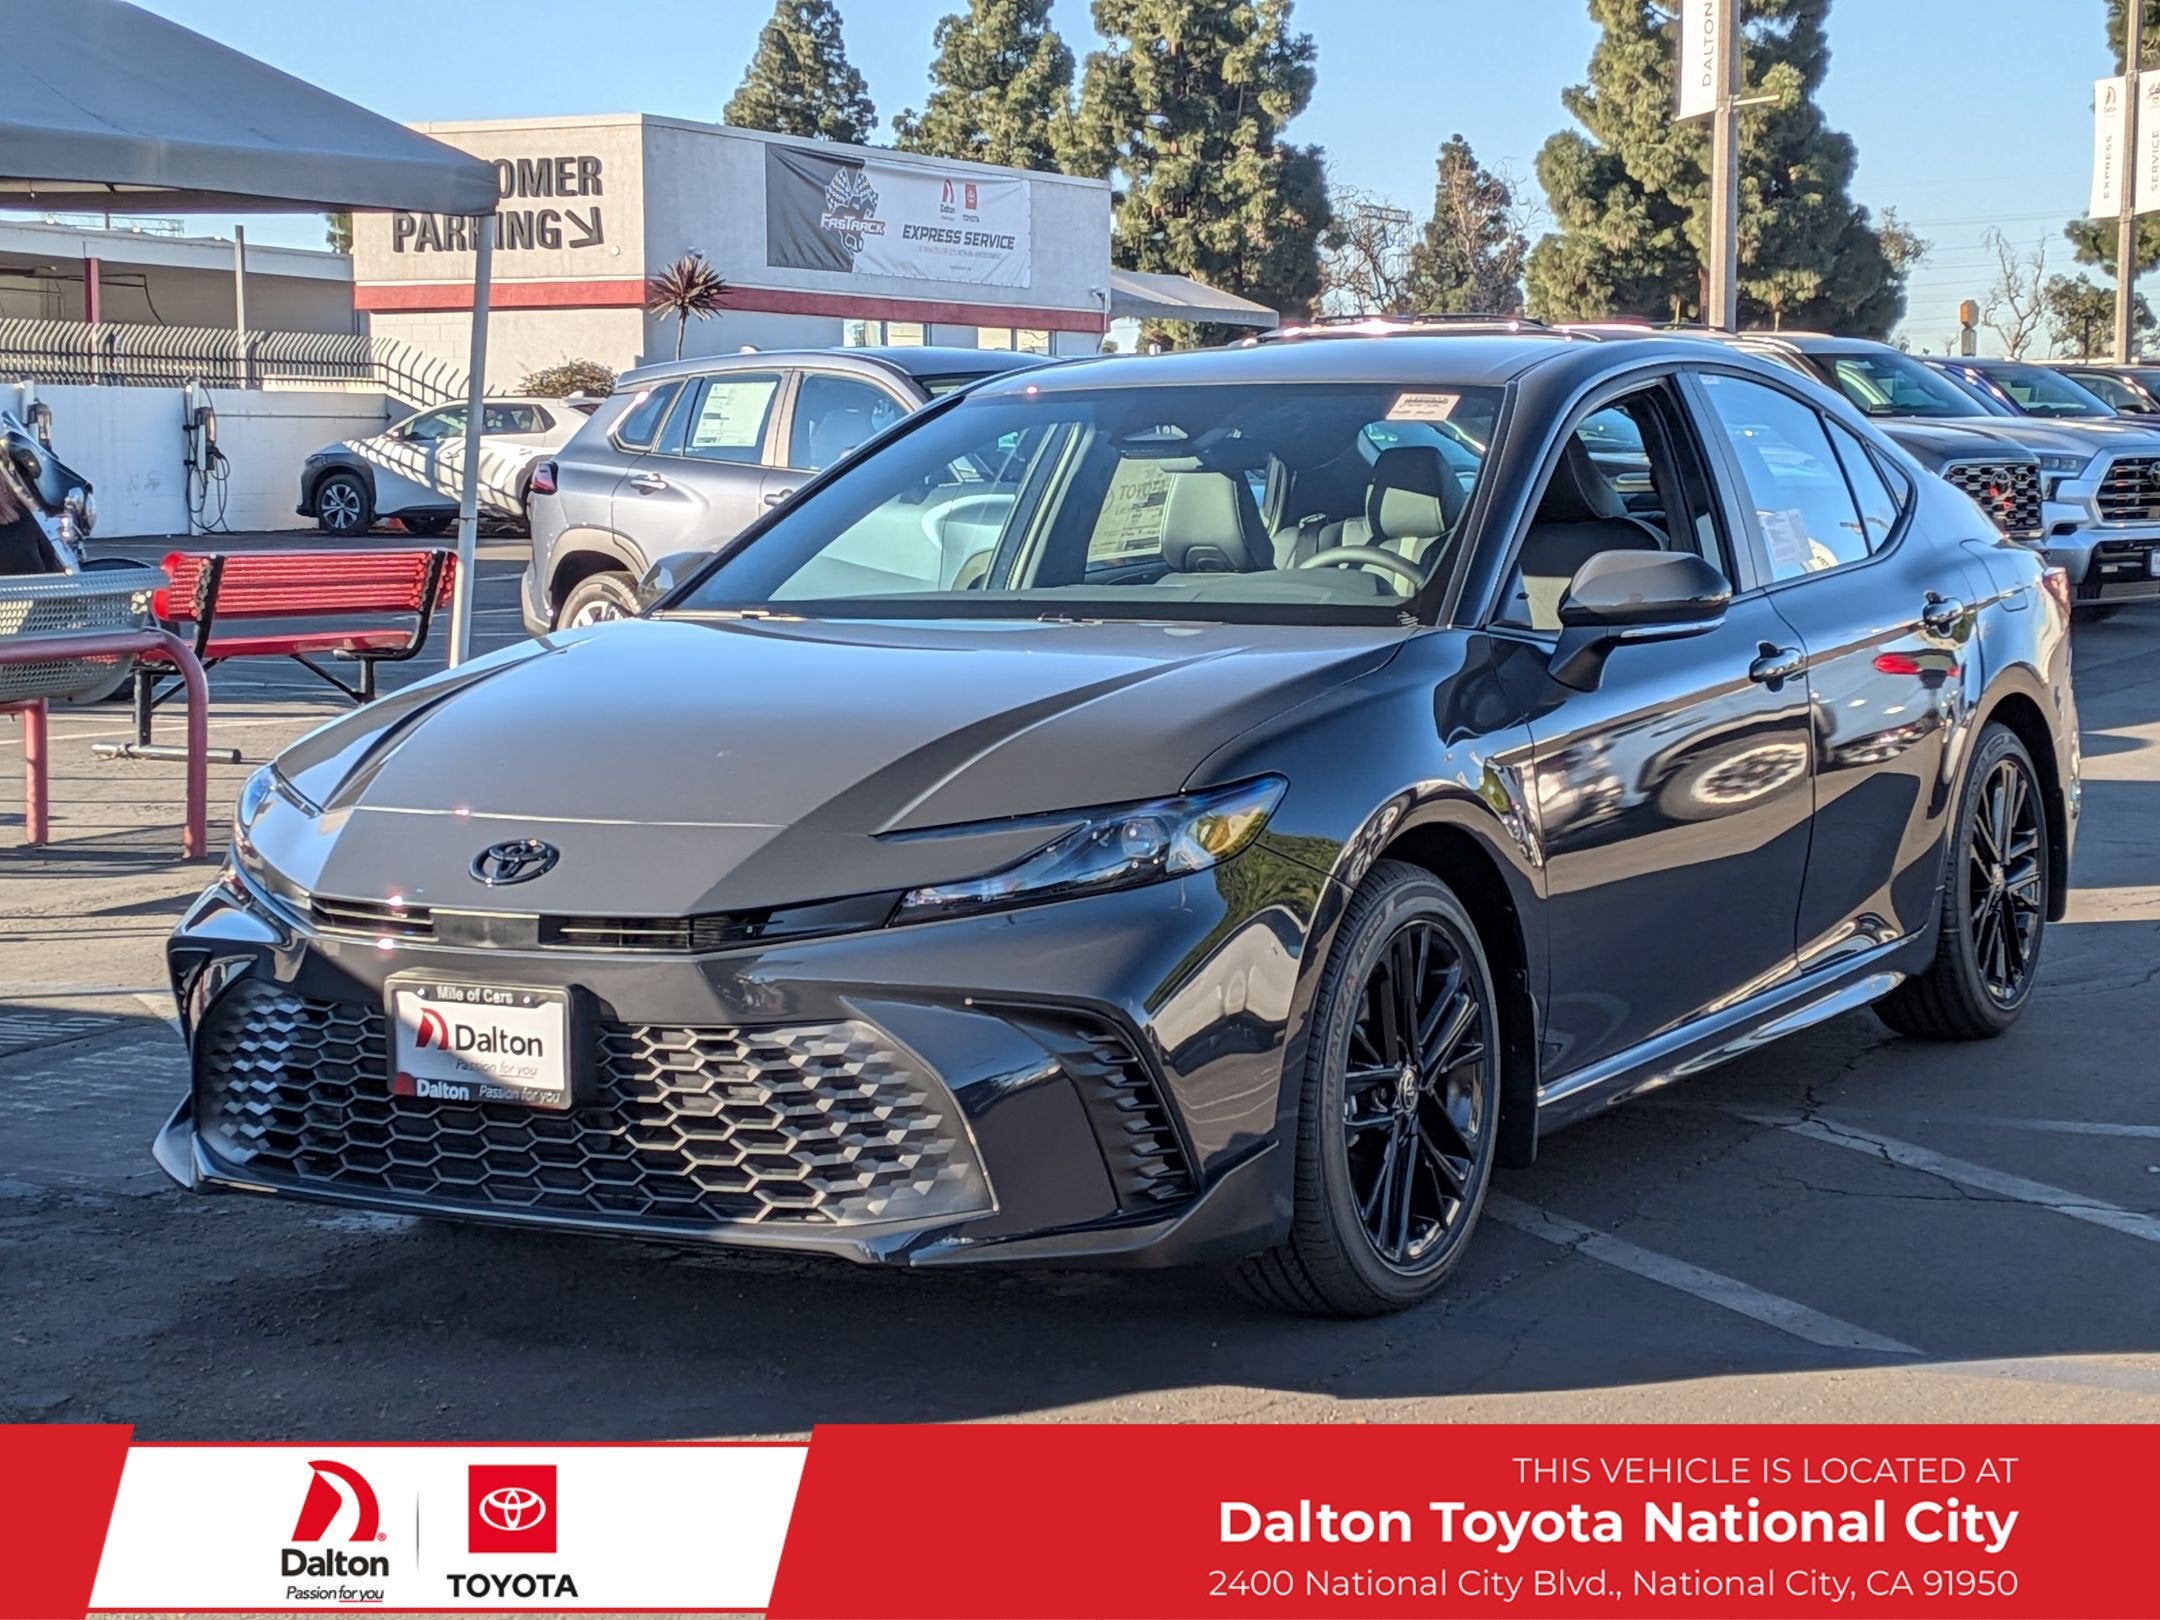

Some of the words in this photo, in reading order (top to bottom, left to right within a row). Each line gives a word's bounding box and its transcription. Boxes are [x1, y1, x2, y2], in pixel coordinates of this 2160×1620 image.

[1702, 1, 1713, 87] DALTON
[2103, 135, 2112, 199] EXPRESS
[2151, 130, 2160, 192] SERVICE
[902, 224, 962, 245] EXPRESS
[963, 231, 1016, 250] SERVICE
[436, 985, 464, 1001] Mile
[467, 988, 480, 1001] of
[483, 990, 514, 1004] Cars
[455, 1024, 544, 1057] Dalton
[455, 1058, 498, 1075] Passion
[499, 1060, 515, 1075] for
[516, 1065, 538, 1078] you
[416, 1078, 470, 1101] Dalton
